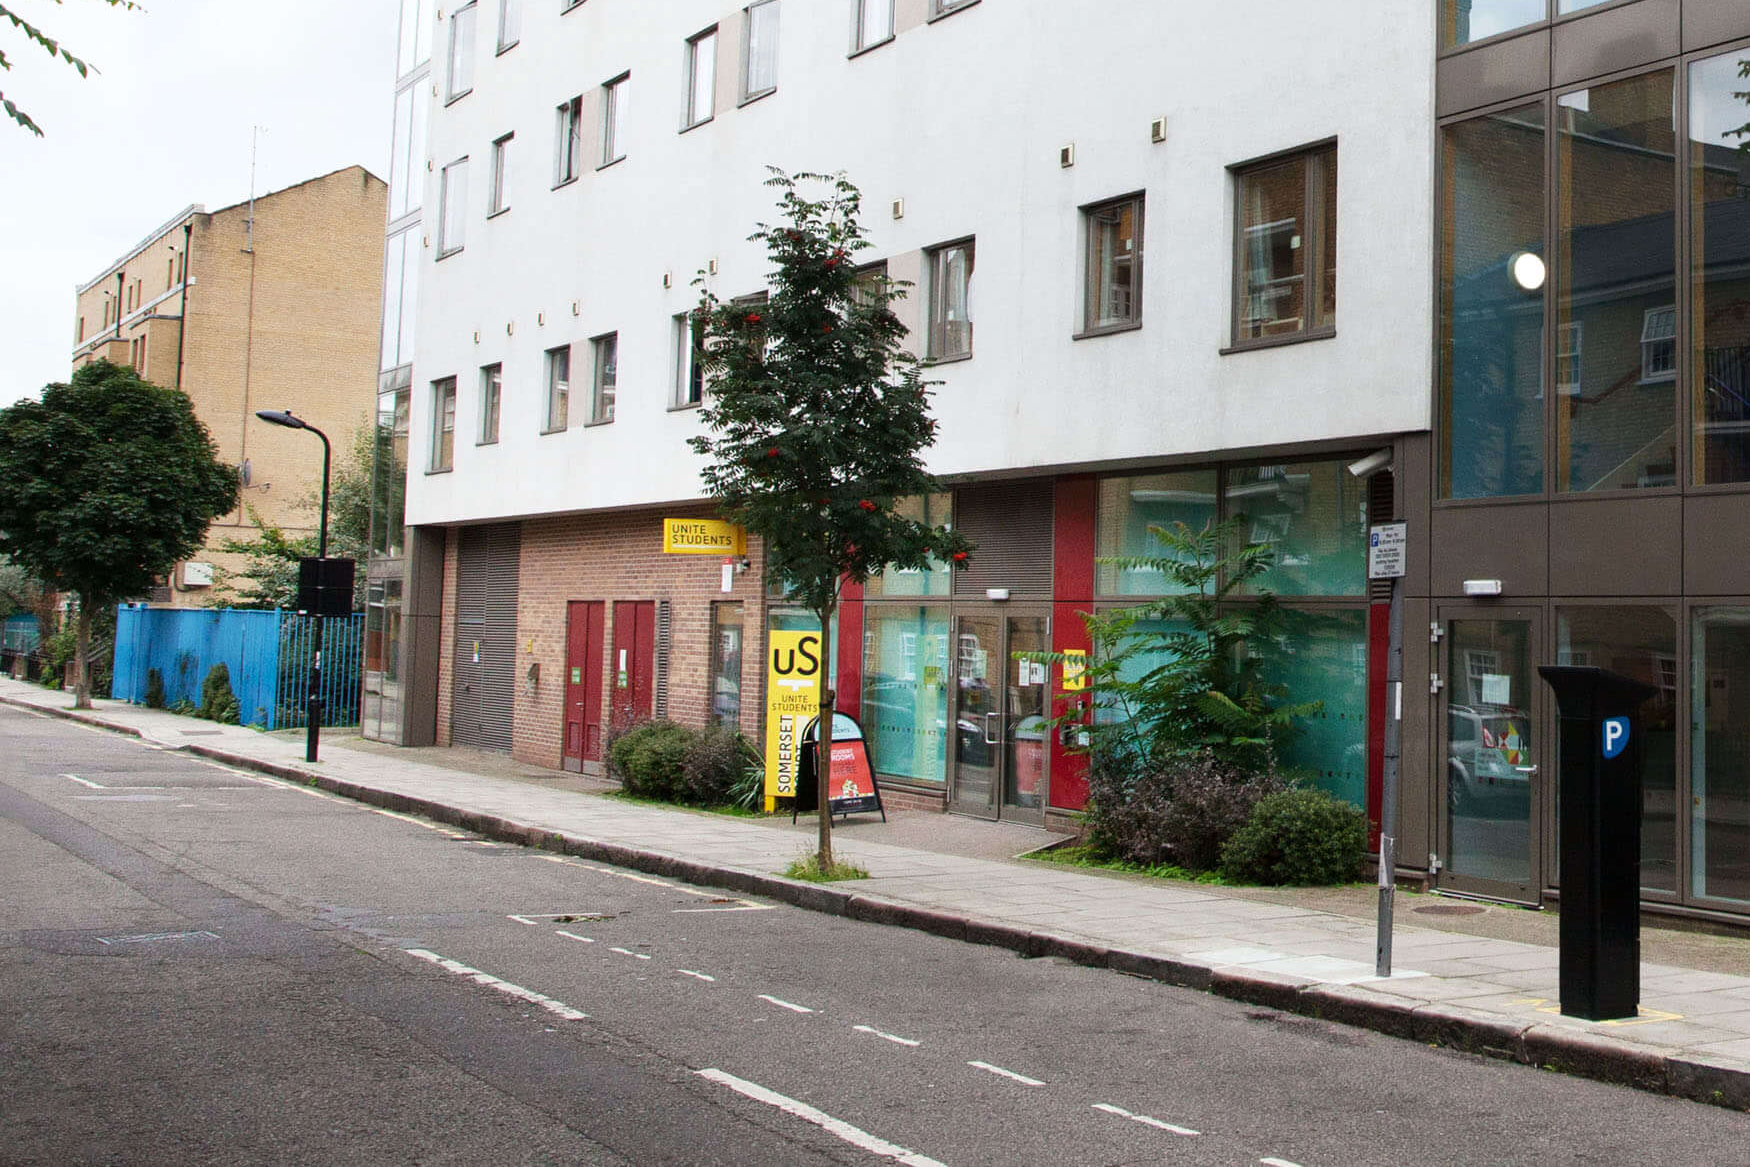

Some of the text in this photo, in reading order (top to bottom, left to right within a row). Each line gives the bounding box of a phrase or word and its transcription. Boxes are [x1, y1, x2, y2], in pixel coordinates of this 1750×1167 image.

[672, 524, 707, 534] UNITE
[672, 534, 732, 545] STUDENTS
[774, 636, 819, 675] uS
[782, 695, 809, 703] UNITE
[771, 702, 818, 712] STUDENTS
[1606, 720, 1623, 751] P
[778, 714, 793, 793] SOMERSET
